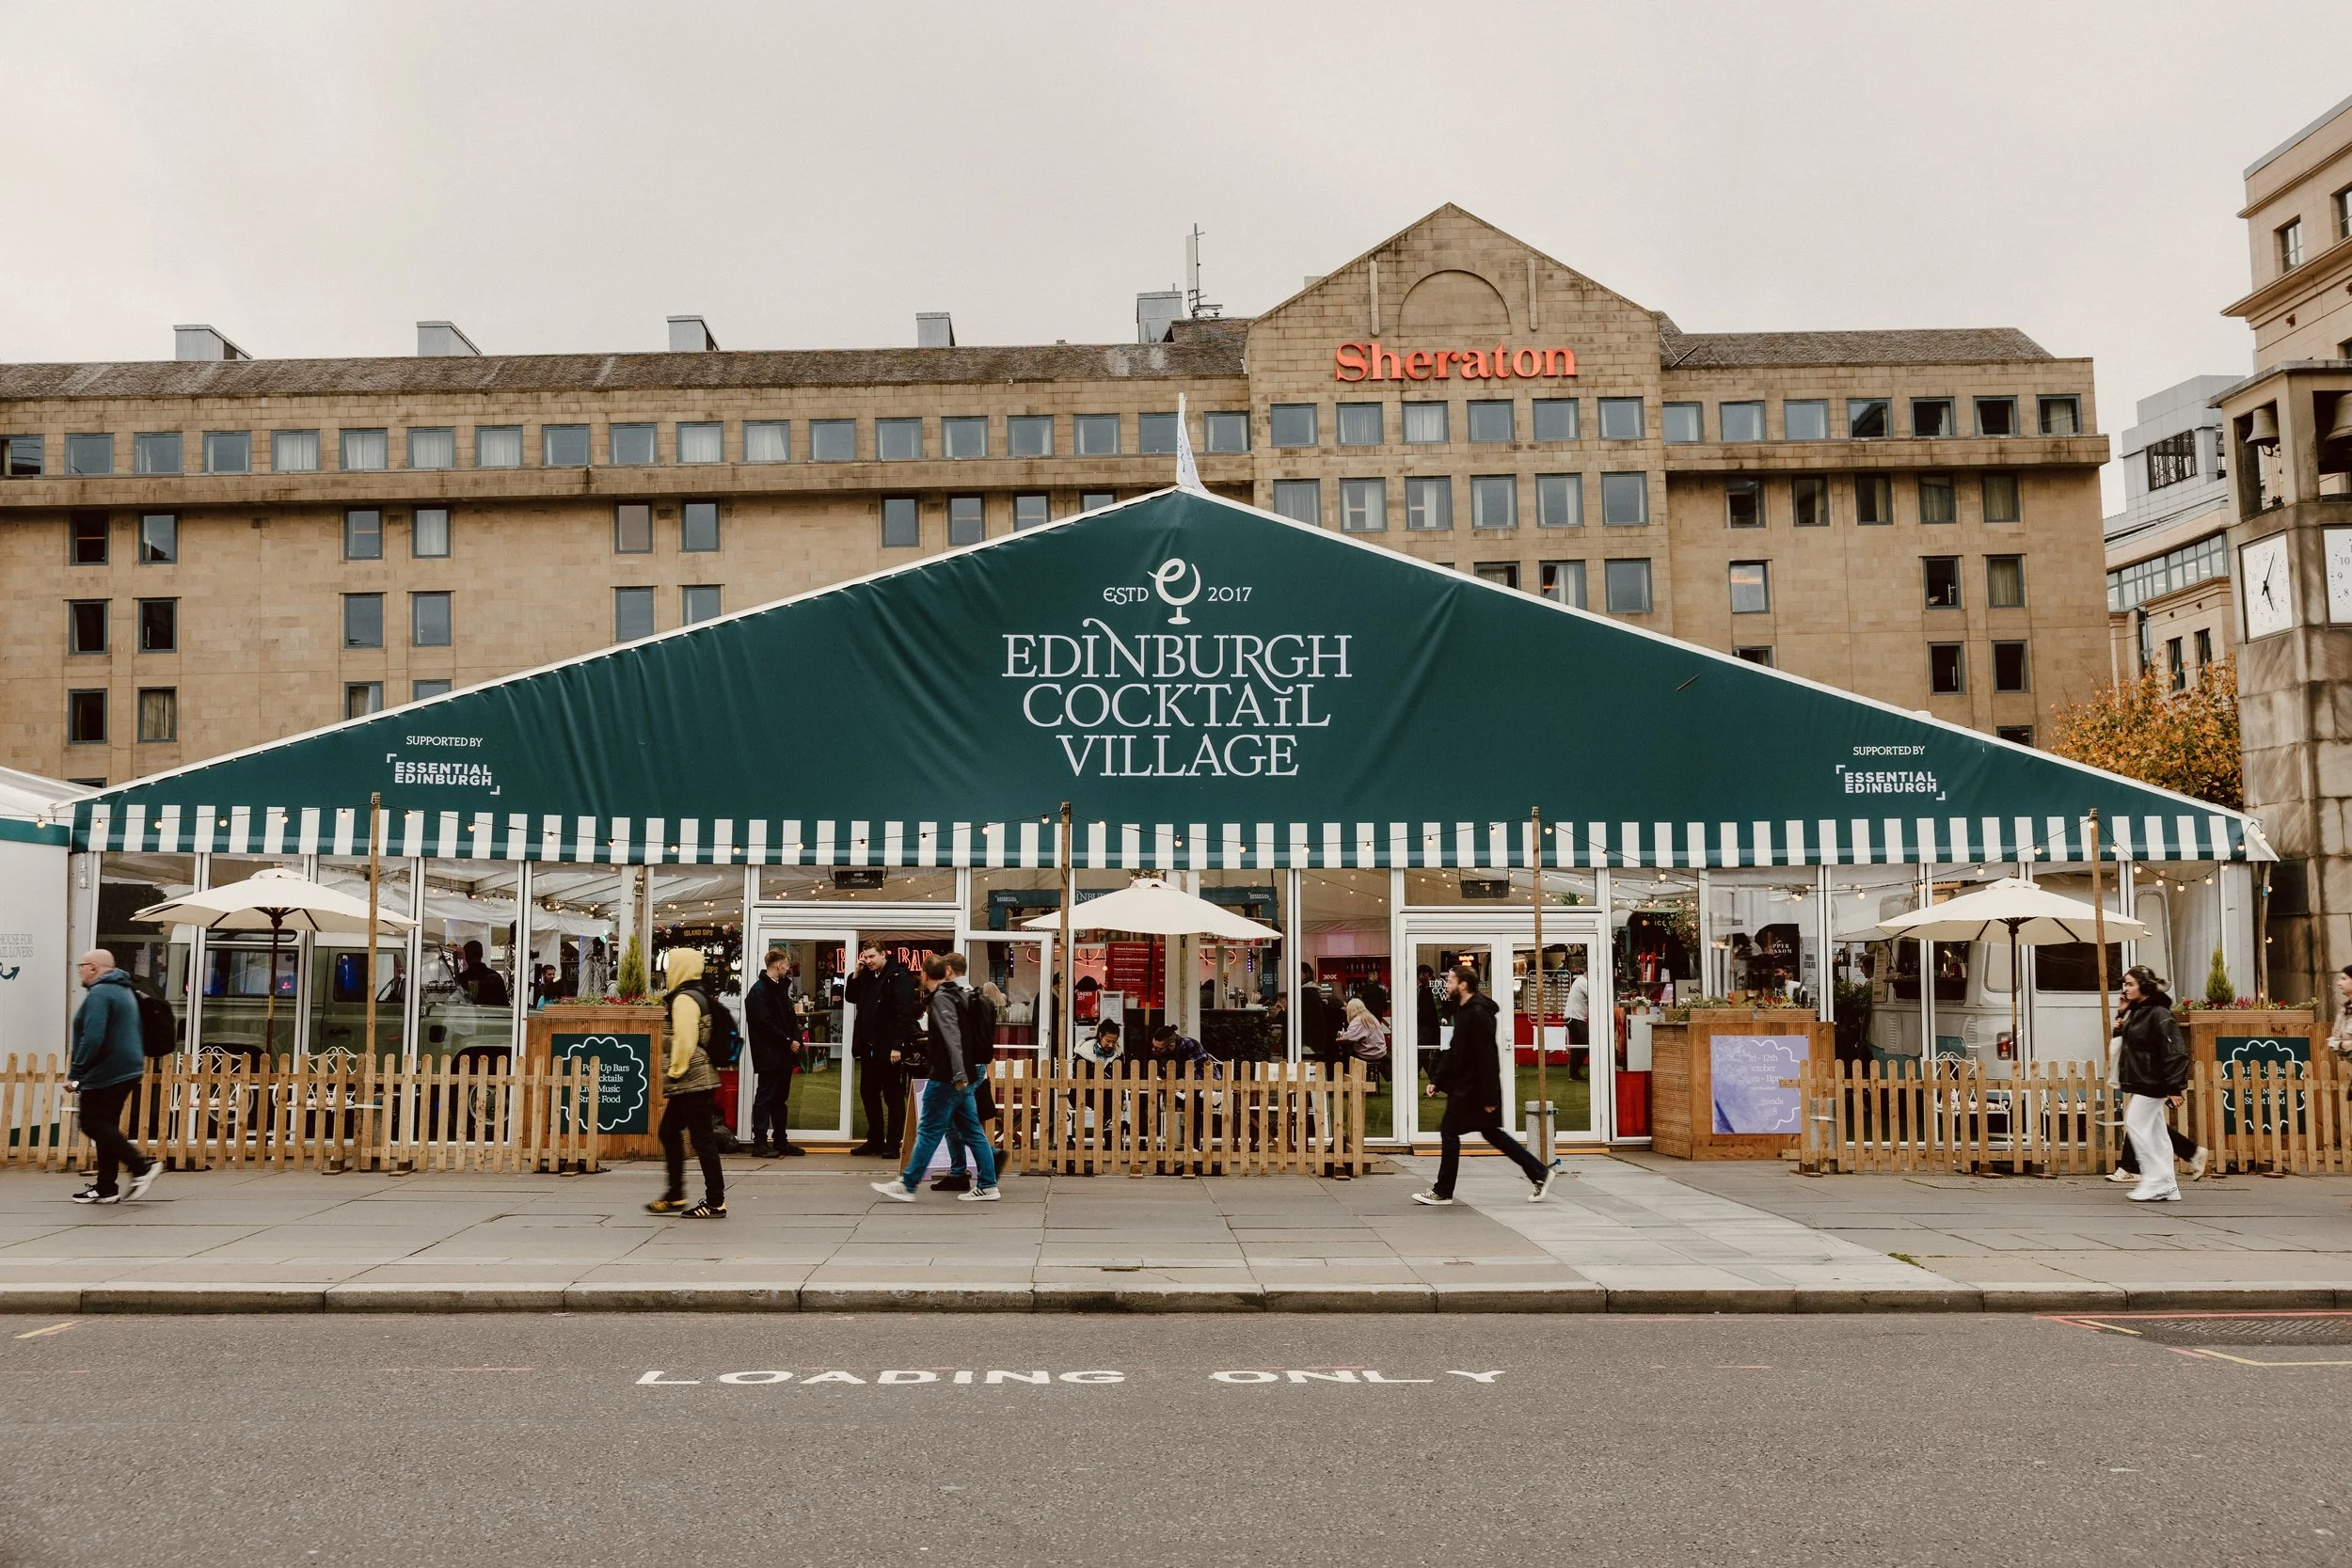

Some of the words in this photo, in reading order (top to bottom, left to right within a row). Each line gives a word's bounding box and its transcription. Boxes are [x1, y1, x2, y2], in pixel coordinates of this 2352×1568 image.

[1336, 341, 1577, 382] Sheraton
[2341, 557, 2350, 565] 10
[2337, 572, 2344, 580] 9
[1103, 587, 1150, 605] ESTD
[1208, 586, 1253, 603] 2017
[2344, 588, 2349, 596] 8
[1001, 618, 1352, 694] EDINBURGH
[1023, 682, 1331, 728] COCKTAIL
[405, 736, 468, 747] SUPPORTED
[469, 737, 484, 747] BY
[1056, 733, 1299, 777] VILLAGE
[1852, 746, 1911, 755] SUPPORTED
[1913, 746, 1925, 755] BY
[395, 761, 492, 775] ESSENTIAL
[394, 772, 492, 786] EDINBURGH
[1844, 771, 1936, 784] ESSENTIAL
[1845, 782, 1937, 794] EDINBURGH
[702, 928, 714, 937] SIPS
[705, 965, 719, 974] SIPS
[1763, 1053, 1778, 1062] 12th
[581, 1064, 612, 1073] PoUp
[613, 1064, 629, 1072] Bars
[1752, 1064, 1776, 1073] ctober
[598, 1074, 624, 1083] cktails
[597, 1085, 621, 1093] Music
[601, 1095, 621, 1103] Food
[635, 1370, 1126, 1386] LOADING
[1210, 1370, 1506, 1385] ONLY
